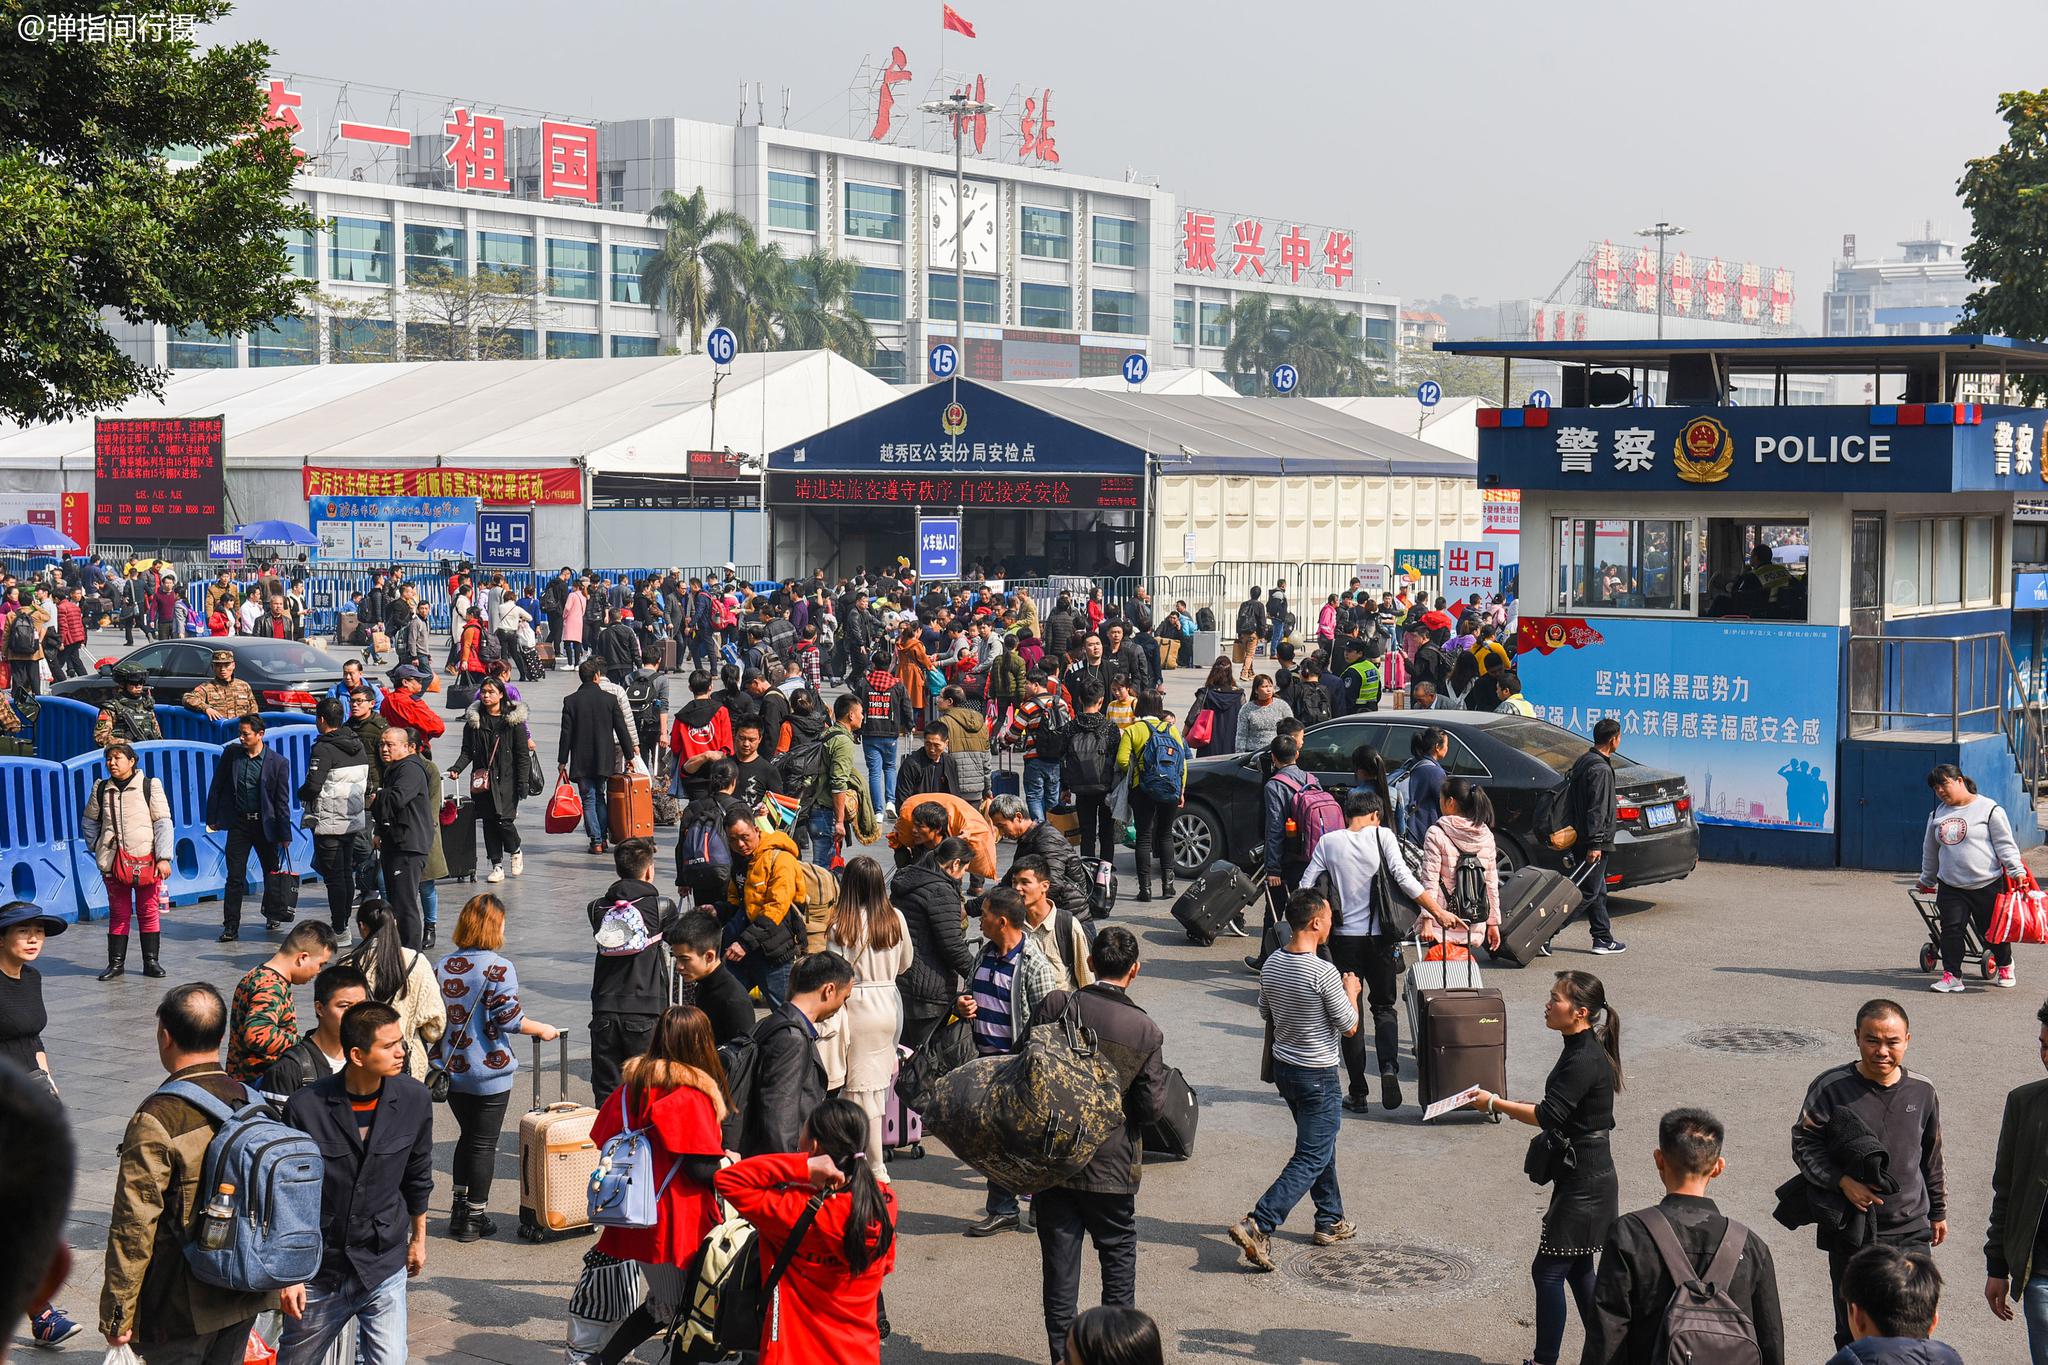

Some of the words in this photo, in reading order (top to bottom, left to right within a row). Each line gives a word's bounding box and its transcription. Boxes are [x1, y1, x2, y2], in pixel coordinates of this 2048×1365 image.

[1182, 209, 1353, 288] 振兴中华
[708, 337, 730, 358] 16
[933, 349, 953, 371] 15
[1126, 358, 1144, 380] 14
[1275, 369, 1293, 389] 13
[1420, 385, 1436, 403] 12
[1533, 393, 1548, 408] 11
[879, 442, 1036, 464] 越秀区公安分局安检点
[1556, 426, 1656, 474] 警察
[1755, 435, 1891, 464] POLICE
[1993, 420, 2034, 476] 警察
[485, 521, 526, 543] 出口
[922, 533, 956, 551] 火车站入口
[489, 547, 521, 557] 只出不进
[1448, 547, 1494, 572] 出口
[1449, 575, 1493, 588] 只出不进
[1595, 669, 1750, 703] 坚决扫除黑恶势力
